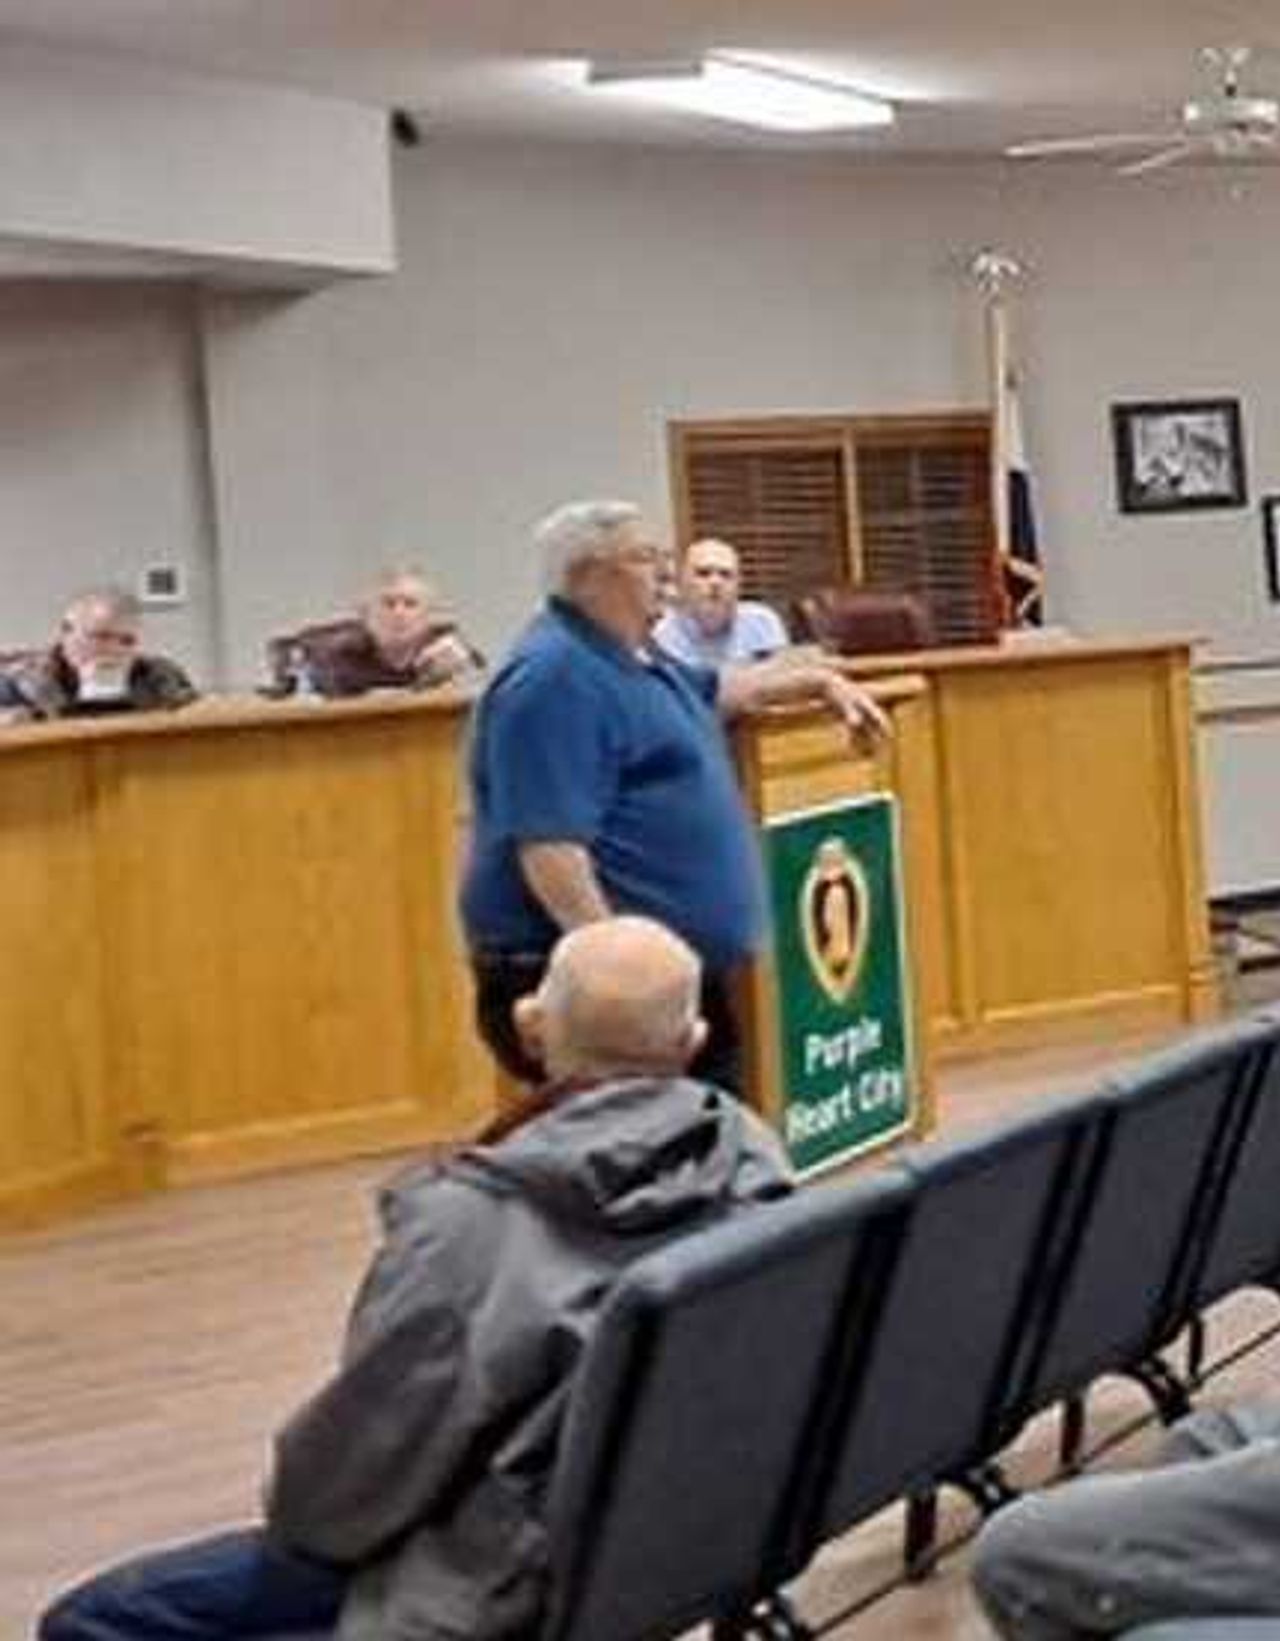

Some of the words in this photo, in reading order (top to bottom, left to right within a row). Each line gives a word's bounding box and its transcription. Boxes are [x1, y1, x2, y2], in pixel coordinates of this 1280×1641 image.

[804, 1016, 881, 1076] Purple
[784, 1082, 855, 1143] Heart
[859, 1068, 903, 1112] City
